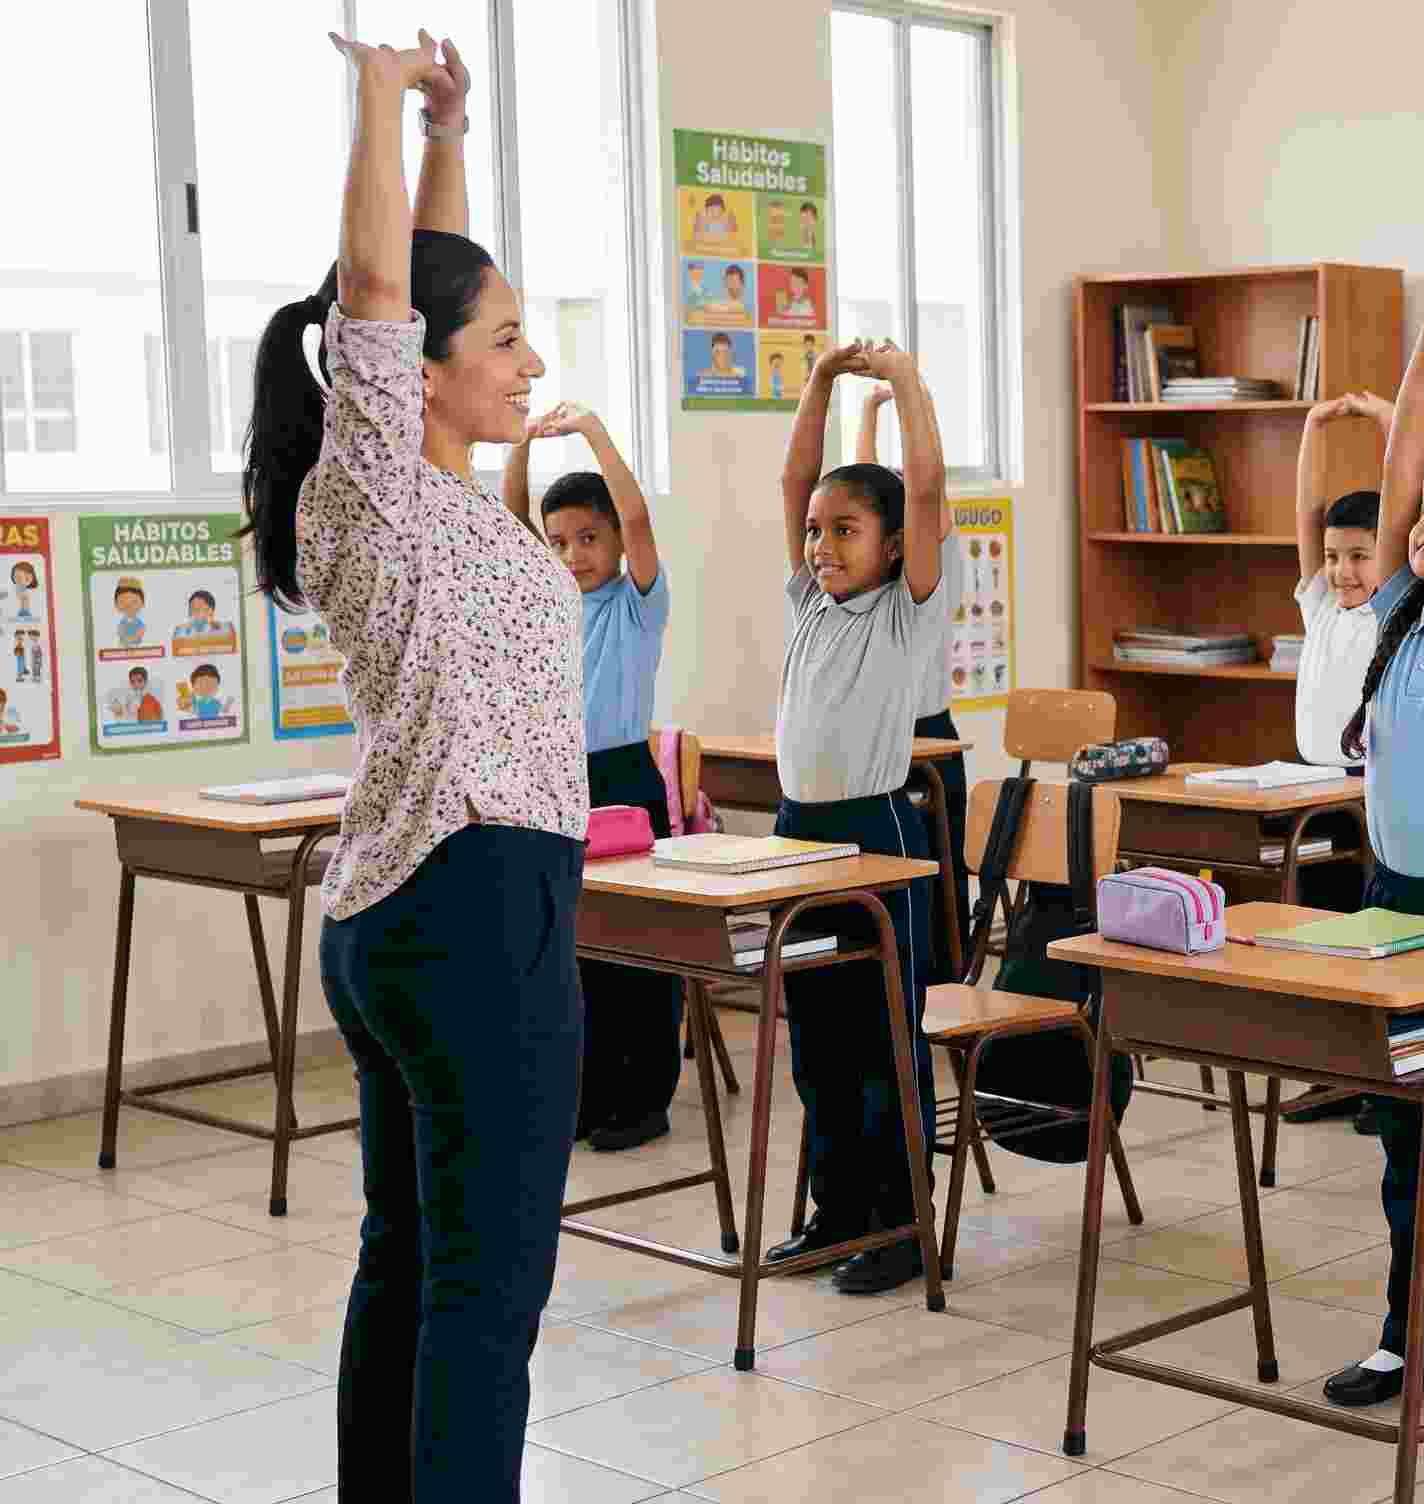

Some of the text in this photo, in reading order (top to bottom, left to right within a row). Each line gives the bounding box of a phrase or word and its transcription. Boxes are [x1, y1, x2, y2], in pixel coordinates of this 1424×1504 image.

[695, 160, 808, 193] Saludables
[113, 518, 210, 544] HÁBITOS
[91, 543, 233, 567] SALUDABLES
